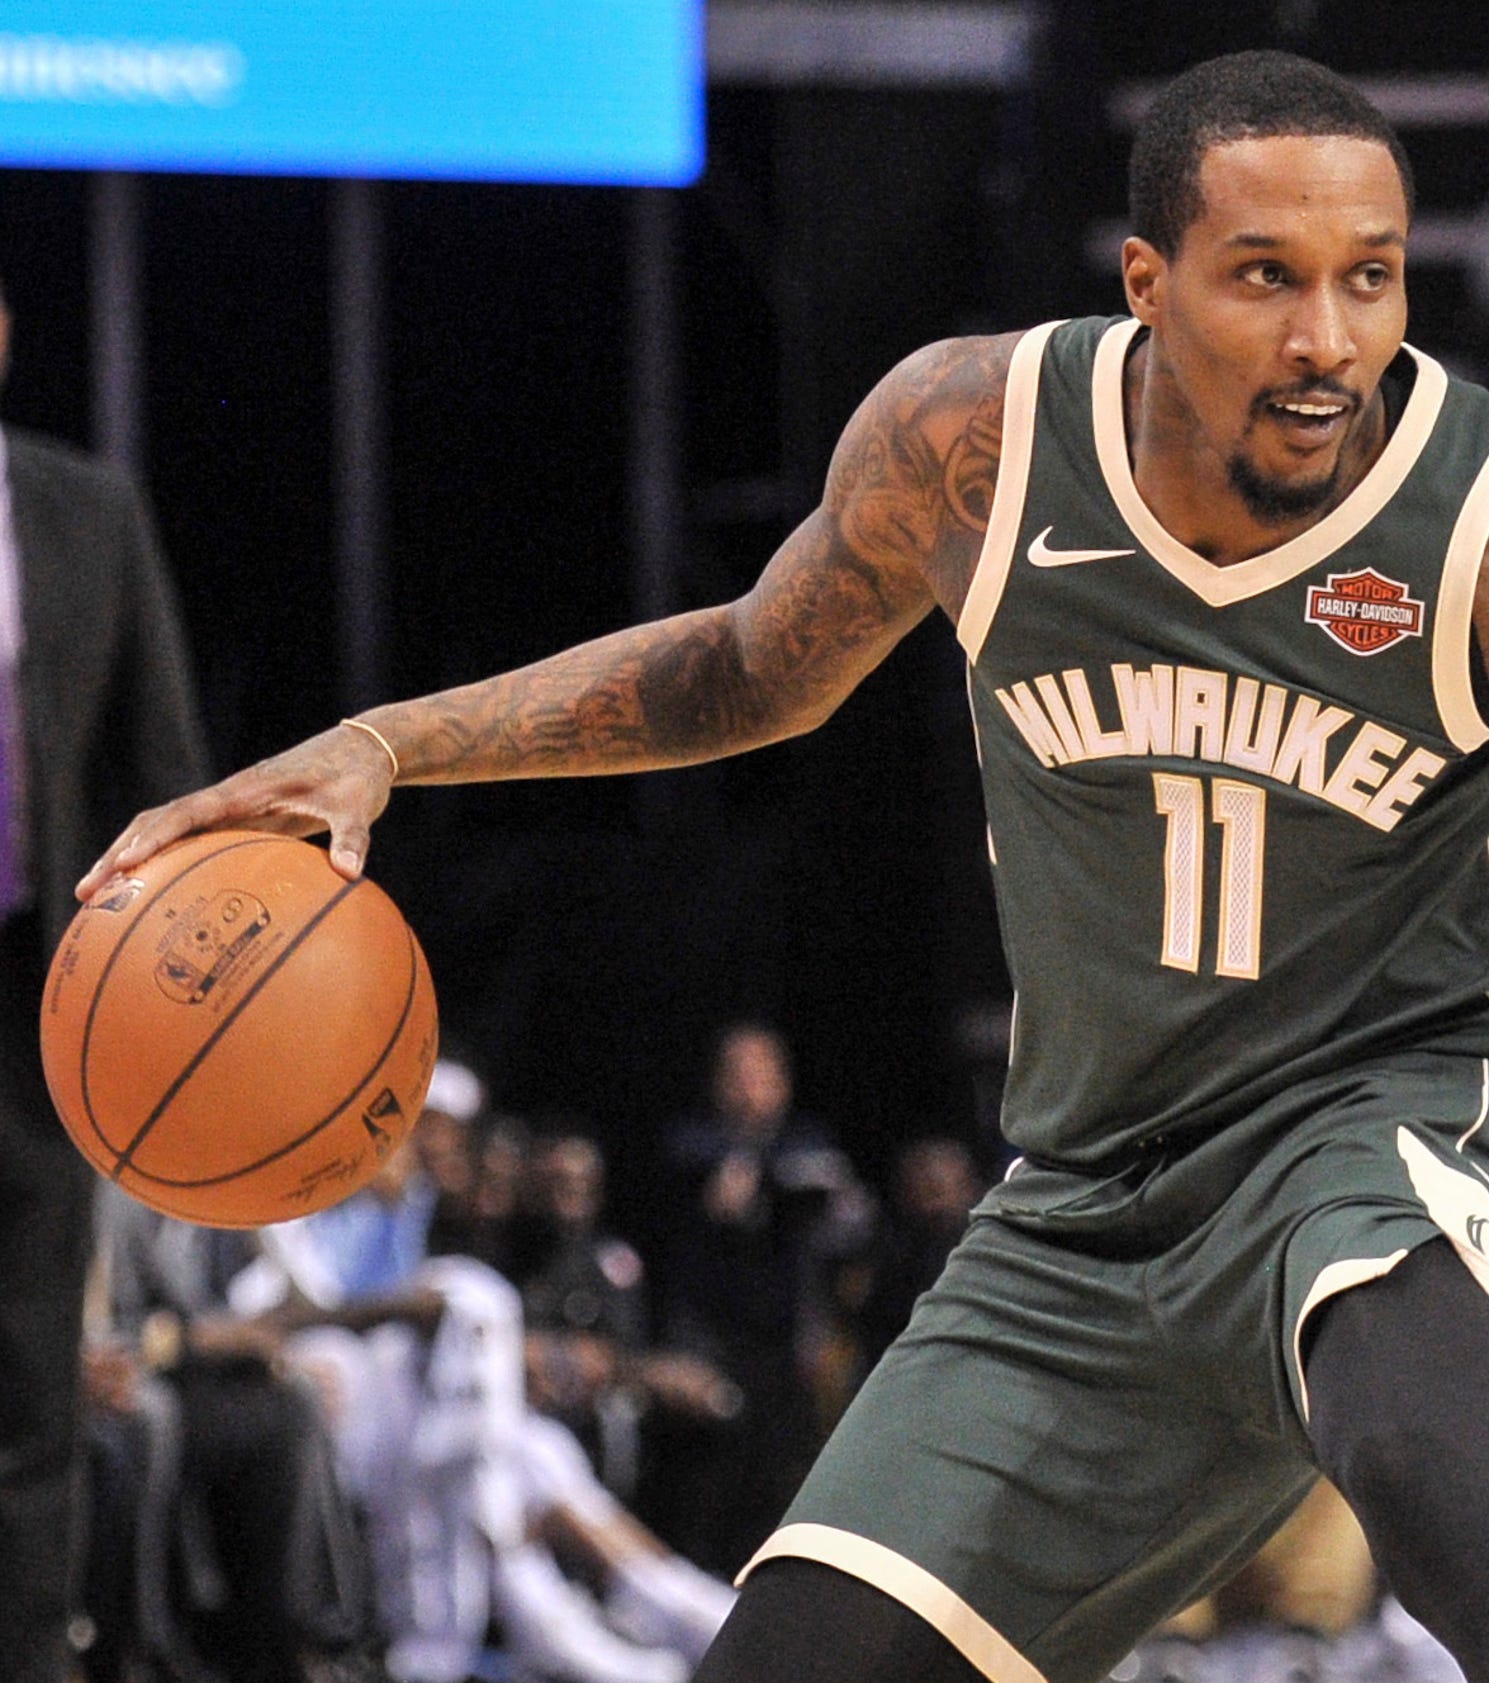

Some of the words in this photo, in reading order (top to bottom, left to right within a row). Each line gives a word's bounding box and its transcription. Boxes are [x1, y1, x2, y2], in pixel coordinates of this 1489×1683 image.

[1341, 580, 1394, 600] MOTOR
[1317, 597, 1414, 626] HARLEY-DAVIDSON
[1337, 621, 1390, 646] CYCLES
[994, 663, 1448, 833] MILWAUKEE
[1152, 772, 1266, 981] 11
